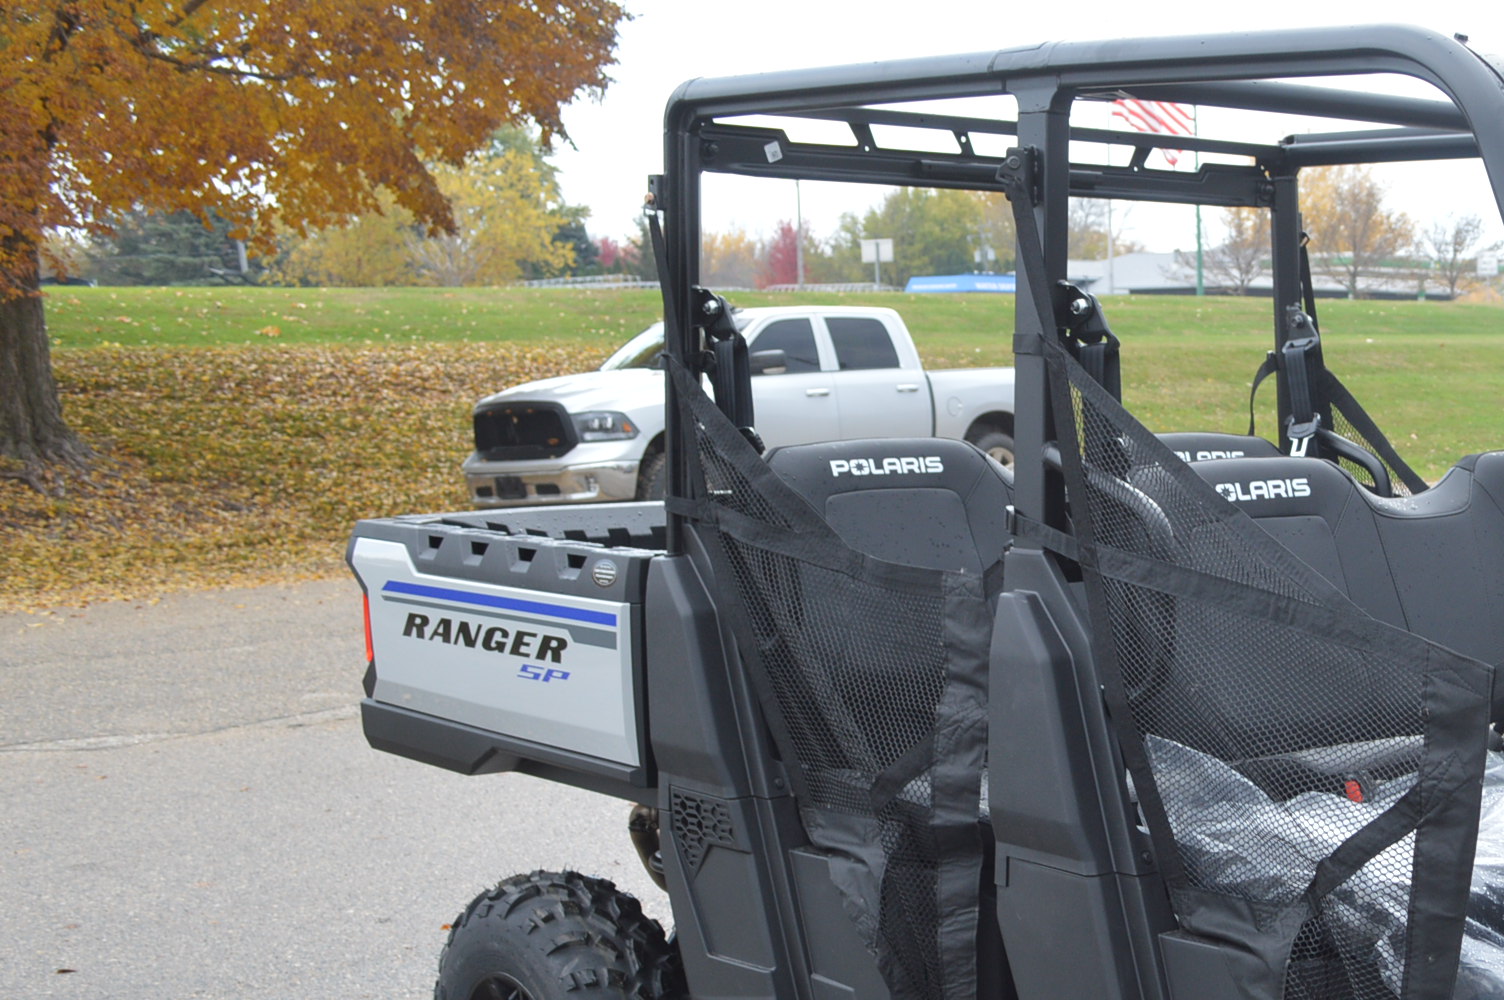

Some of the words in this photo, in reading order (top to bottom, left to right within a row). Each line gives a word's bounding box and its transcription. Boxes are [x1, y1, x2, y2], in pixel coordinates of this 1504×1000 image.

[829, 456, 944, 477] POLARIS
[1173, 450, 1244, 462] LARI
[1215, 478, 1311, 502] OLARIS
[402, 612, 568, 664] RANGER
[517, 664, 571, 683] SP
